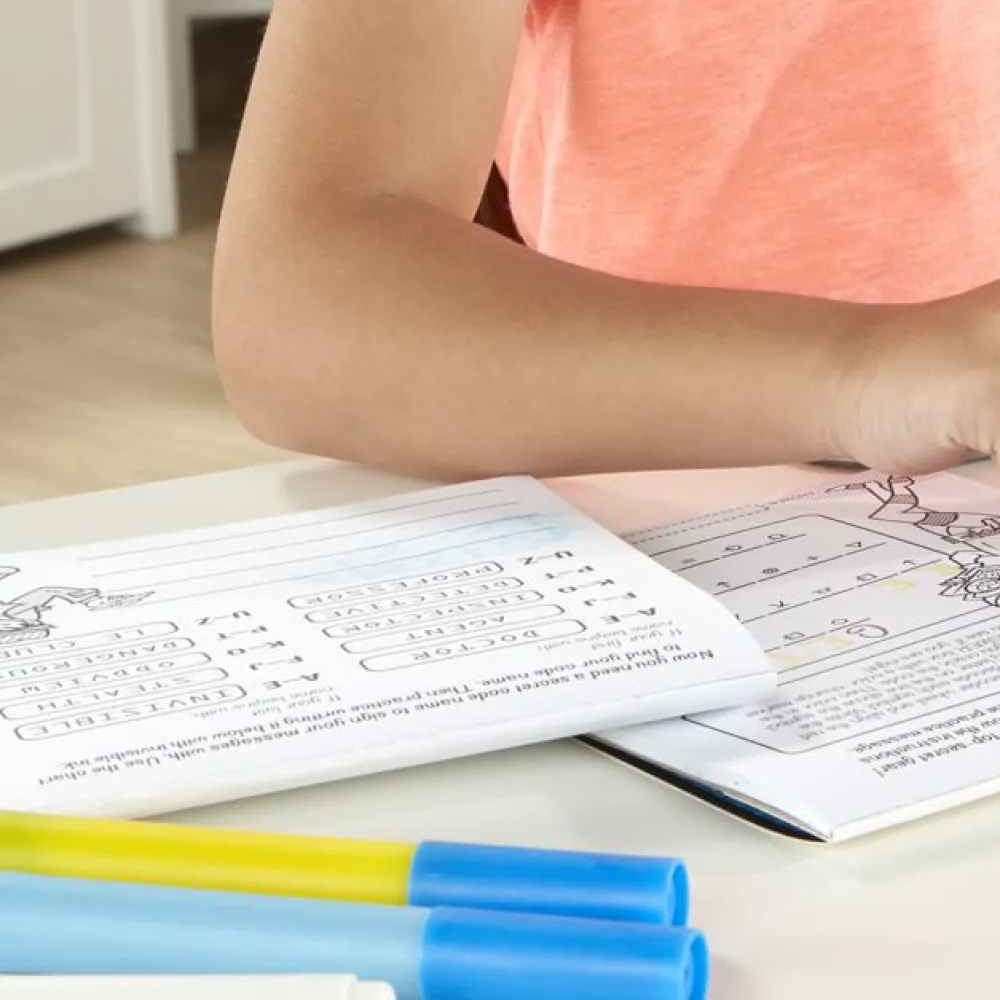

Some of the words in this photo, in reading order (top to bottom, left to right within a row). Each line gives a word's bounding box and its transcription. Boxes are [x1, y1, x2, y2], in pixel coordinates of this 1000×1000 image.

[307, 565, 492, 604] PROFESSOR
[327, 580, 509, 620] DETECTIVE
[342, 594, 525, 633] INSPECTOR
[406, 615, 507, 641] AGENT
[411, 629, 541, 661] DOCTOR
[635, 655, 668, 669] you
[672, 649, 714, 662] Now
[573, 672, 585, 680] a
[589, 664, 632, 680] need
[515, 676, 570, 693] secret
[36, 676, 191, 711] STEALTH
[468, 687, 510, 701] code
[391, 707, 410, 715] to
[415, 696, 464, 710] name
[32, 689, 229, 736] INVISIBLE
[349, 711, 387, 723] sign
[307, 718, 346, 733] your
[210, 729, 299, 751] messages
[918, 733, 1000, 762] top-secret
[125, 756, 161, 767] Use
[164, 747, 205, 761] with.
[92, 764, 119, 773] the
[872, 755, 916, 777] gear!
[38, 769, 87, 785] chart
